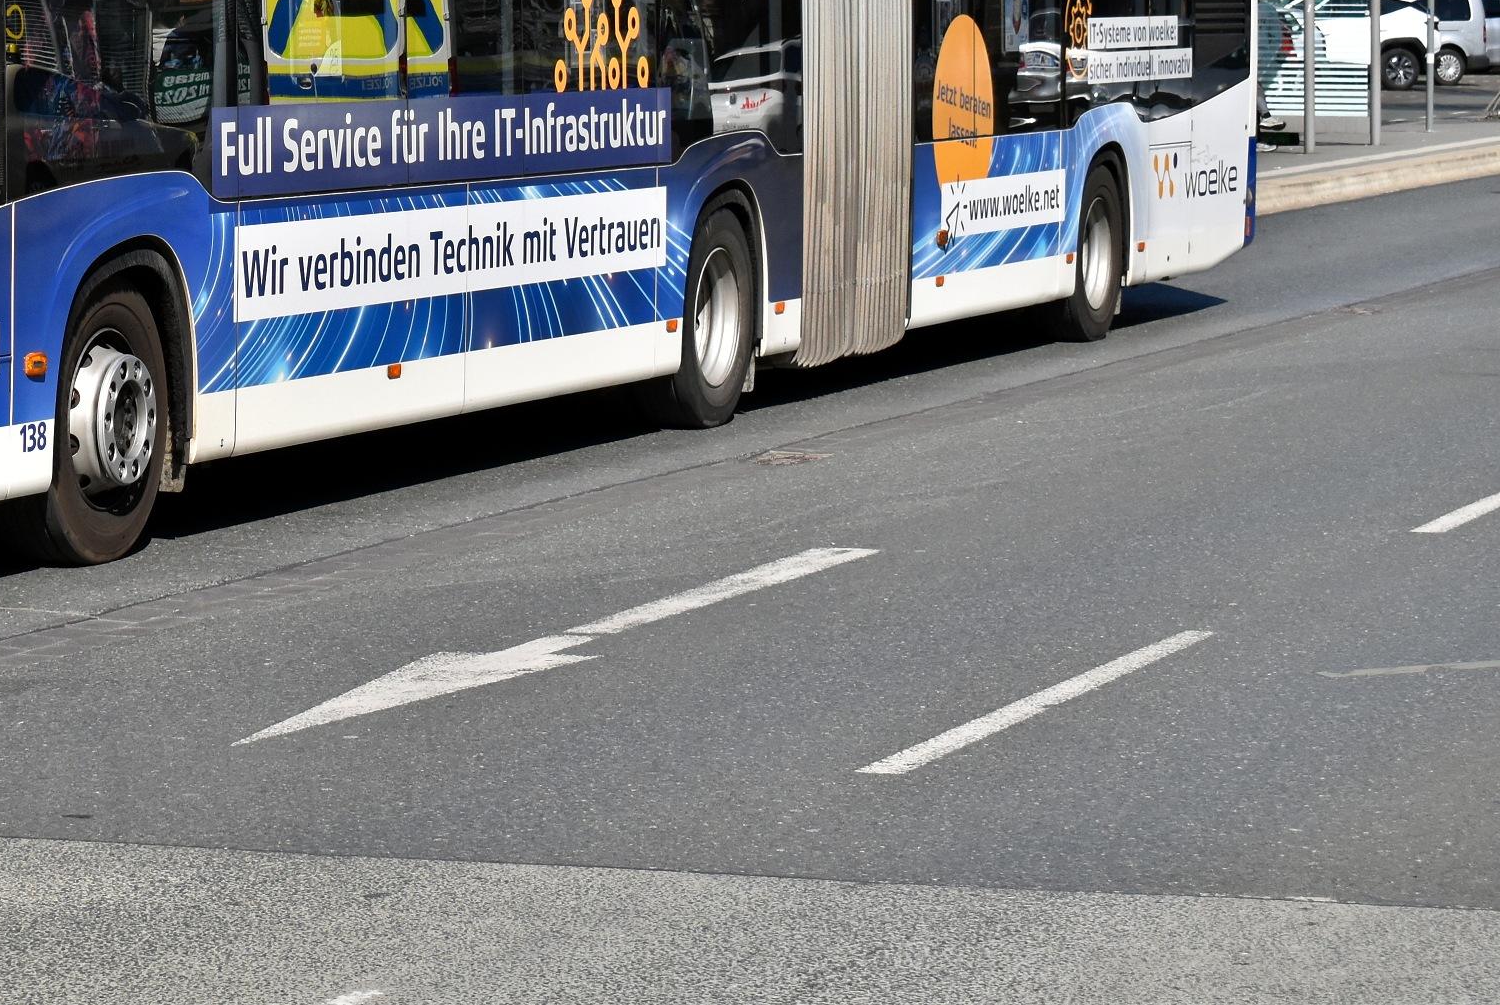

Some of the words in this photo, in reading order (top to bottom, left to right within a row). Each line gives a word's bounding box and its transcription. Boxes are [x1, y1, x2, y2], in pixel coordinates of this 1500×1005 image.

[1089, 20, 1131, 49] IT-Systeme
[1133, 26, 1147, 42] von
[1149, 20, 1177, 42] woelke:
[1157, 53, 1191, 76] innovativ
[936, 80, 957, 106] Jetzt
[959, 87, 991, 119] beraten
[220, 116, 272, 176] Full
[283, 112, 382, 173] Service
[391, 109, 429, 164] für
[438, 107, 485, 160] Ihre
[494, 98, 666, 157] IT-Infrastruktur
[948, 117, 978, 149] lassen!
[1184, 160, 1238, 199] woelke
[969, 183, 1060, 221] www.woelke.net
[242, 244, 288, 298] Wir
[298, 233, 420, 292] verbinden
[430, 221, 514, 276] Technik
[522, 217, 556, 264] mit
[564, 216, 661, 259] Vertrauen
[19, 421, 47, 453] 138
